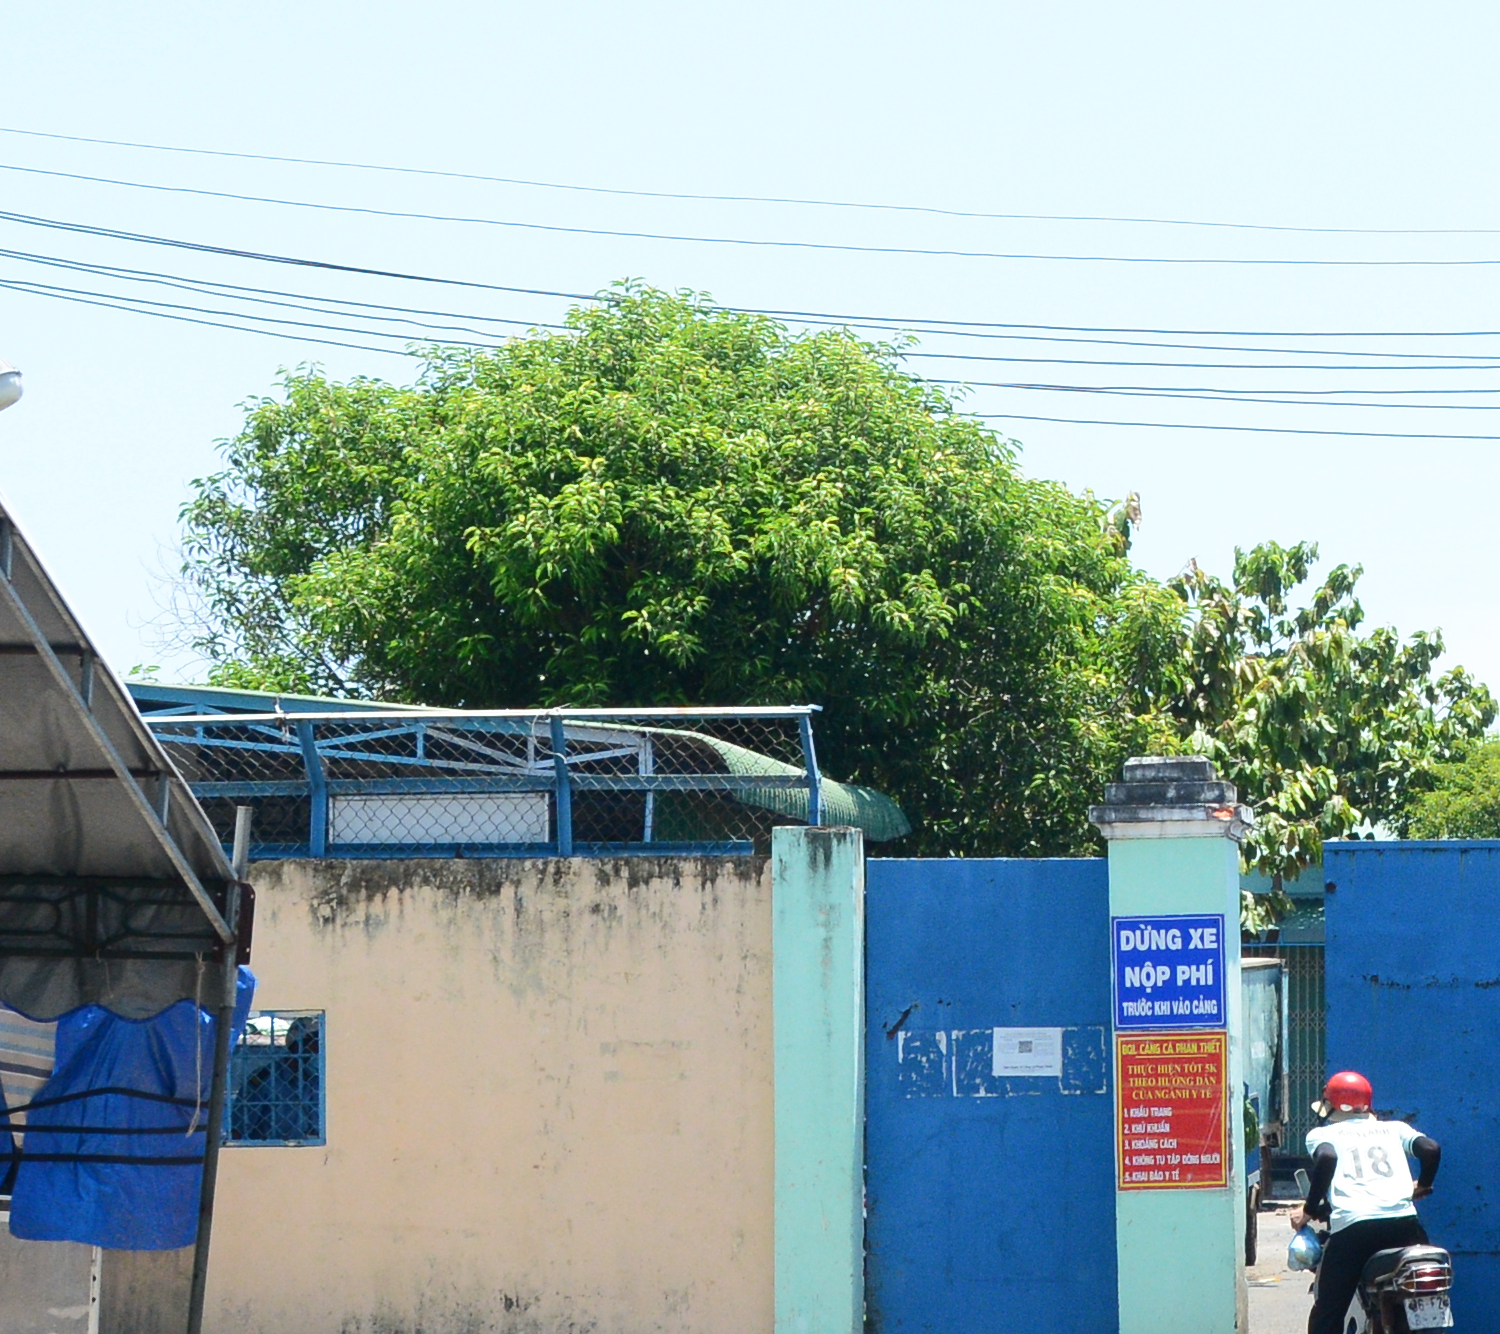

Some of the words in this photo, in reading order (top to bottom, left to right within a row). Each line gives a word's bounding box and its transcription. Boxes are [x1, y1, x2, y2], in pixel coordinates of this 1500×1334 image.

[1120, 924, 1182, 951] DỪNG
[1188, 928, 1218, 949] XE
[1125, 961, 1170, 993] NỘP
[1177, 959, 1213, 986] PHÍ
[1154, 1001, 1170, 1015] KHI
[1192, 994, 1218, 1015] CẢNG
[1129, 1077, 1156, 1087] THEO
[1191, 1089, 1198, 1098] Y
[1347, 1146, 1394, 1178] 18
